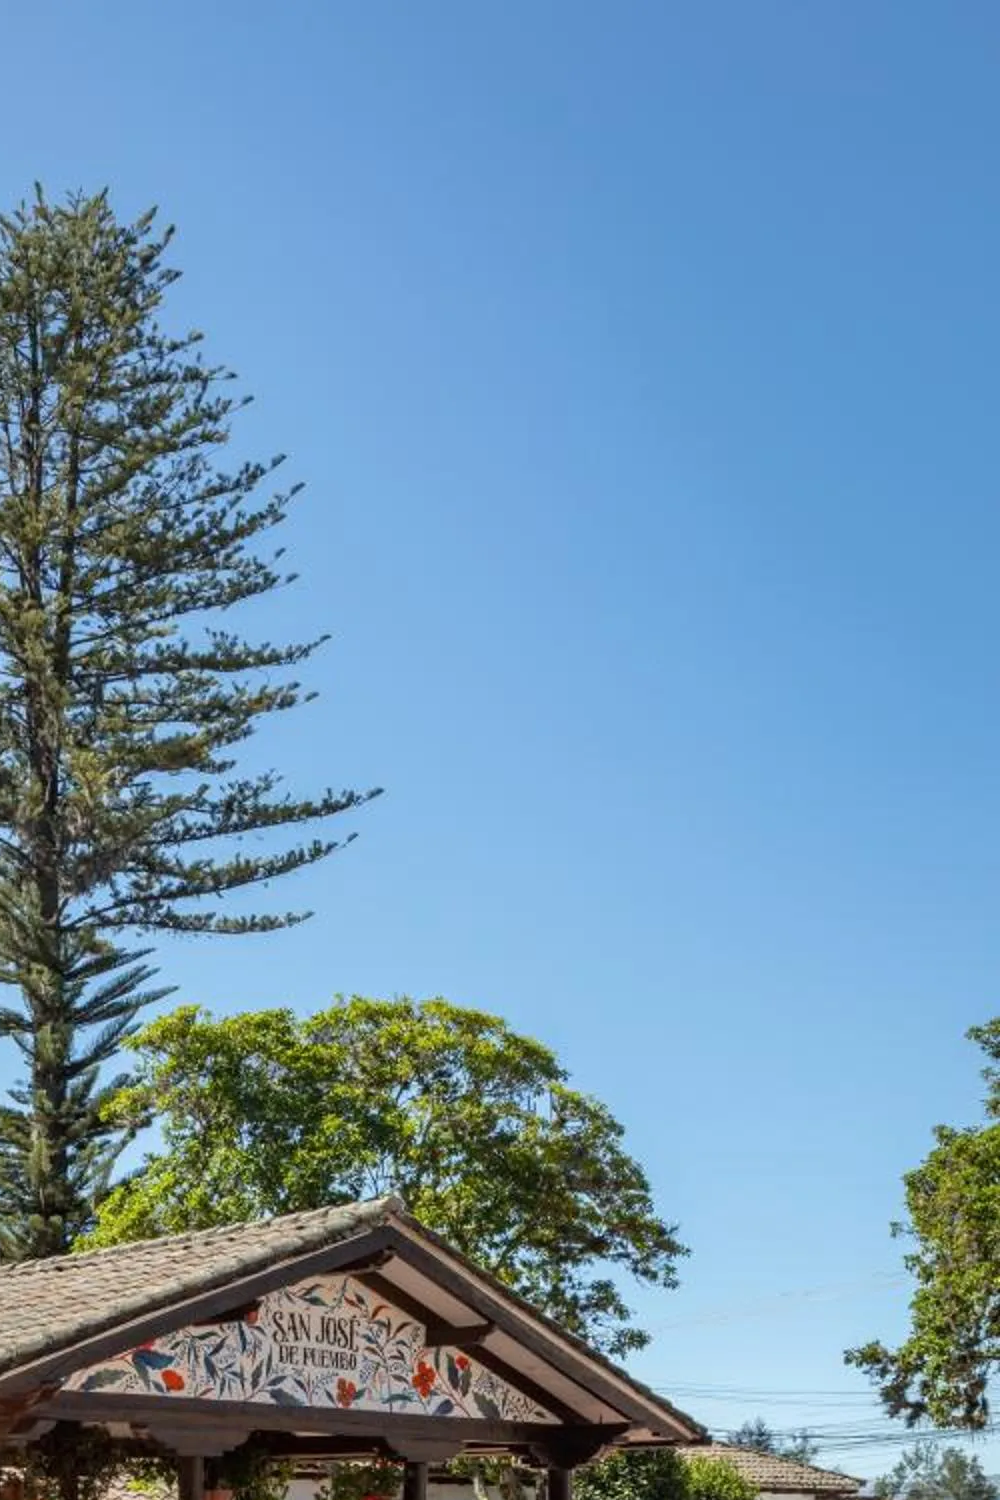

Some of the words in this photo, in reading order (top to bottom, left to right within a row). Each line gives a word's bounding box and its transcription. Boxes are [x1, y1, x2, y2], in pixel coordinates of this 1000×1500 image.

[272, 1311, 311, 1343] SAN
[315, 1315, 361, 1353] JOSÉ
[278, 1345, 299, 1365] DE
[303, 1347, 357, 1370] PUEMBO
